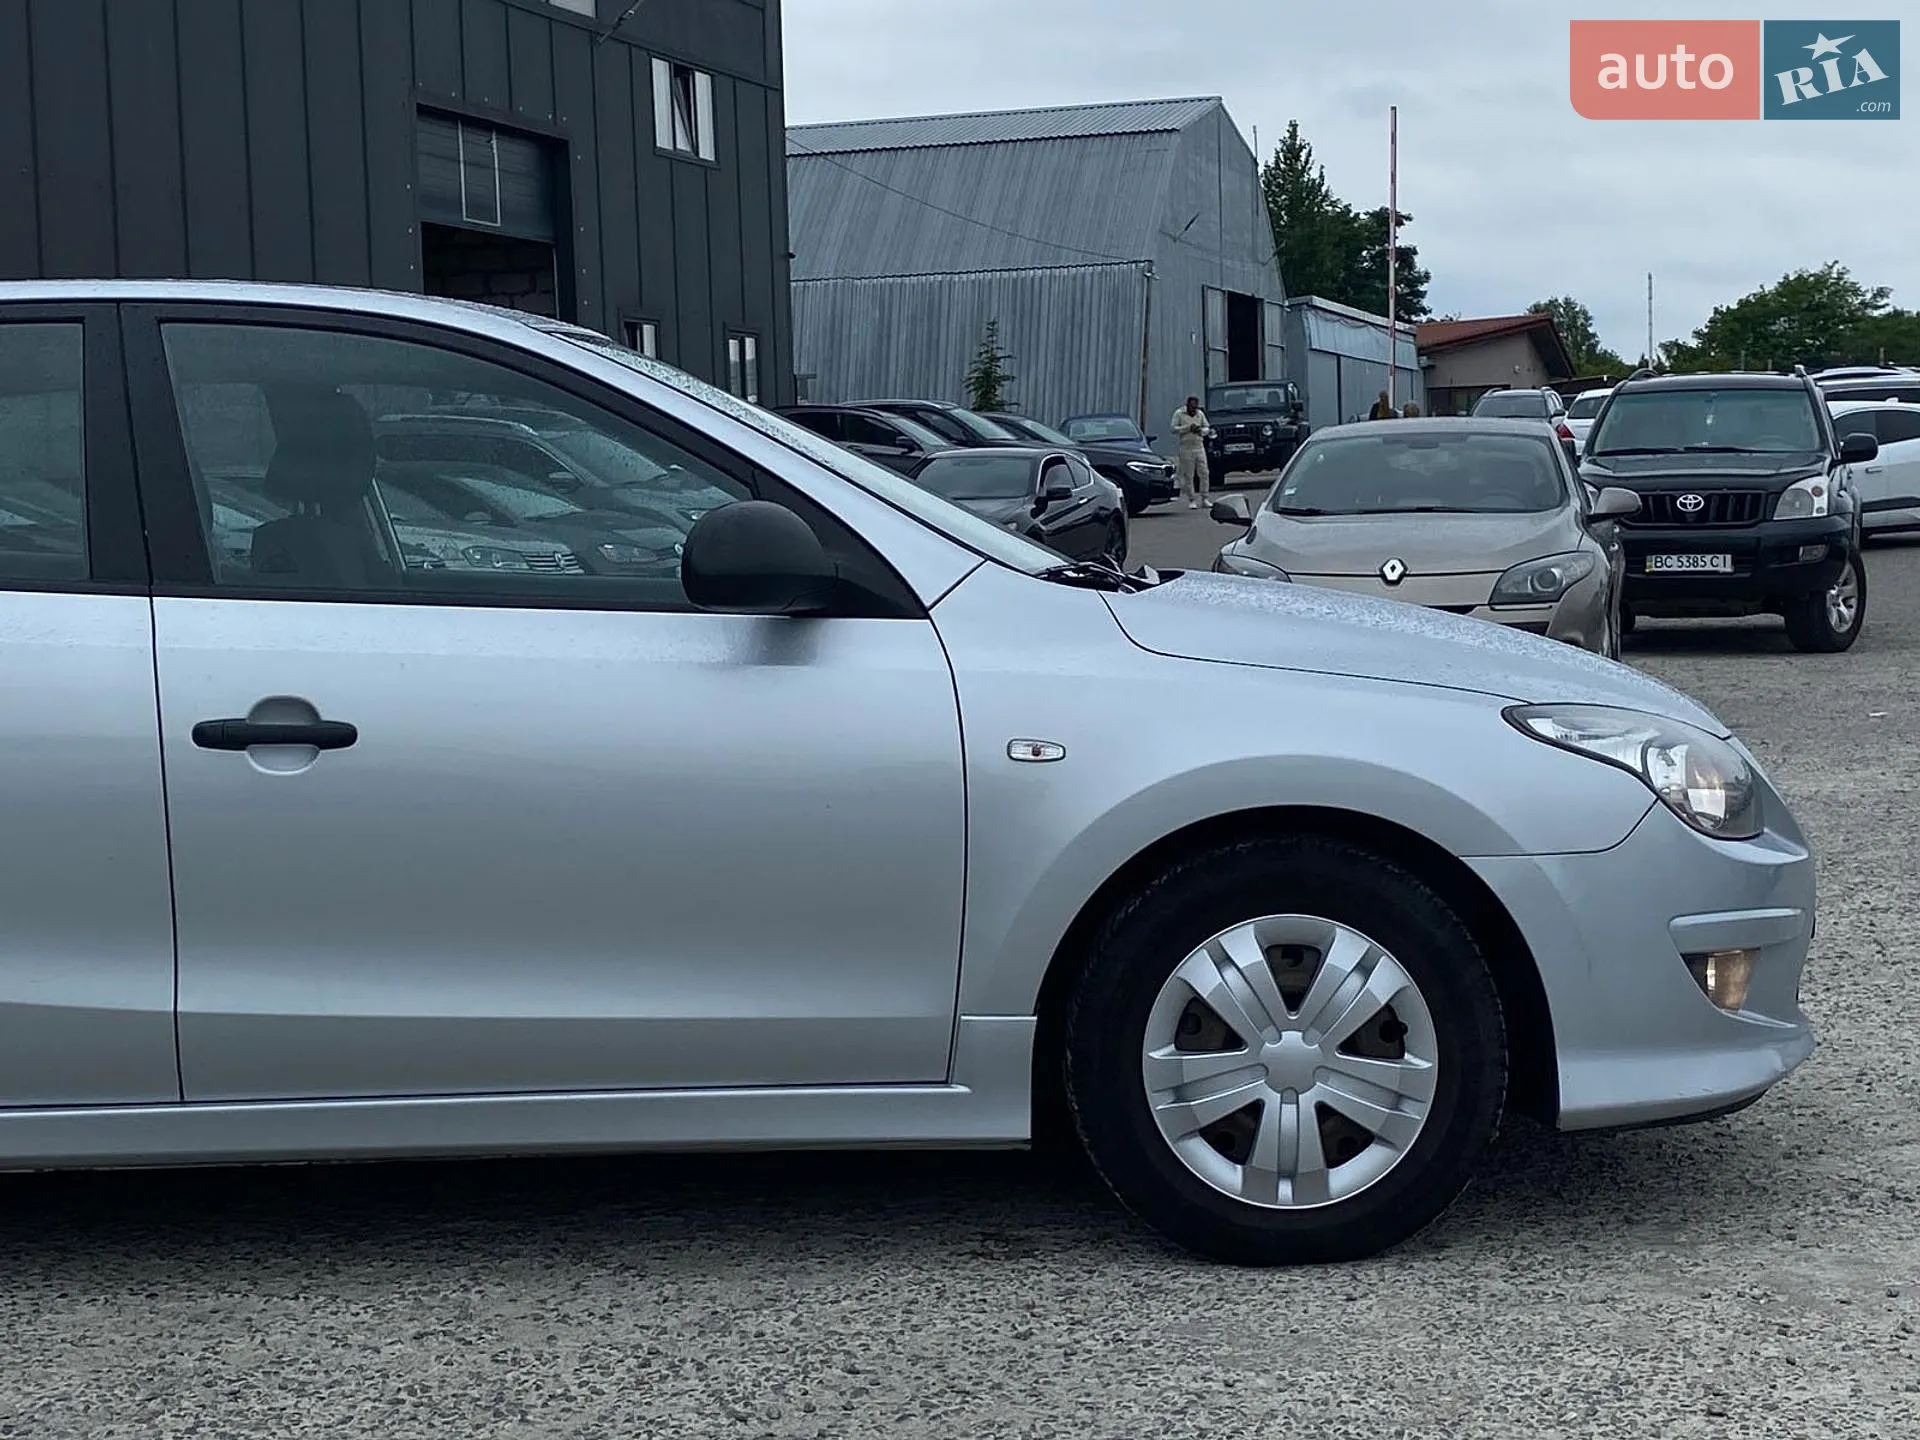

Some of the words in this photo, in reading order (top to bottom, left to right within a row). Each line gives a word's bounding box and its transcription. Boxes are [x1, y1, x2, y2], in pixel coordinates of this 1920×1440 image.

[1654, 555, 1673, 569] BC
[1677, 555, 1707, 569] 5385
[1710, 555, 1727, 569] CI
